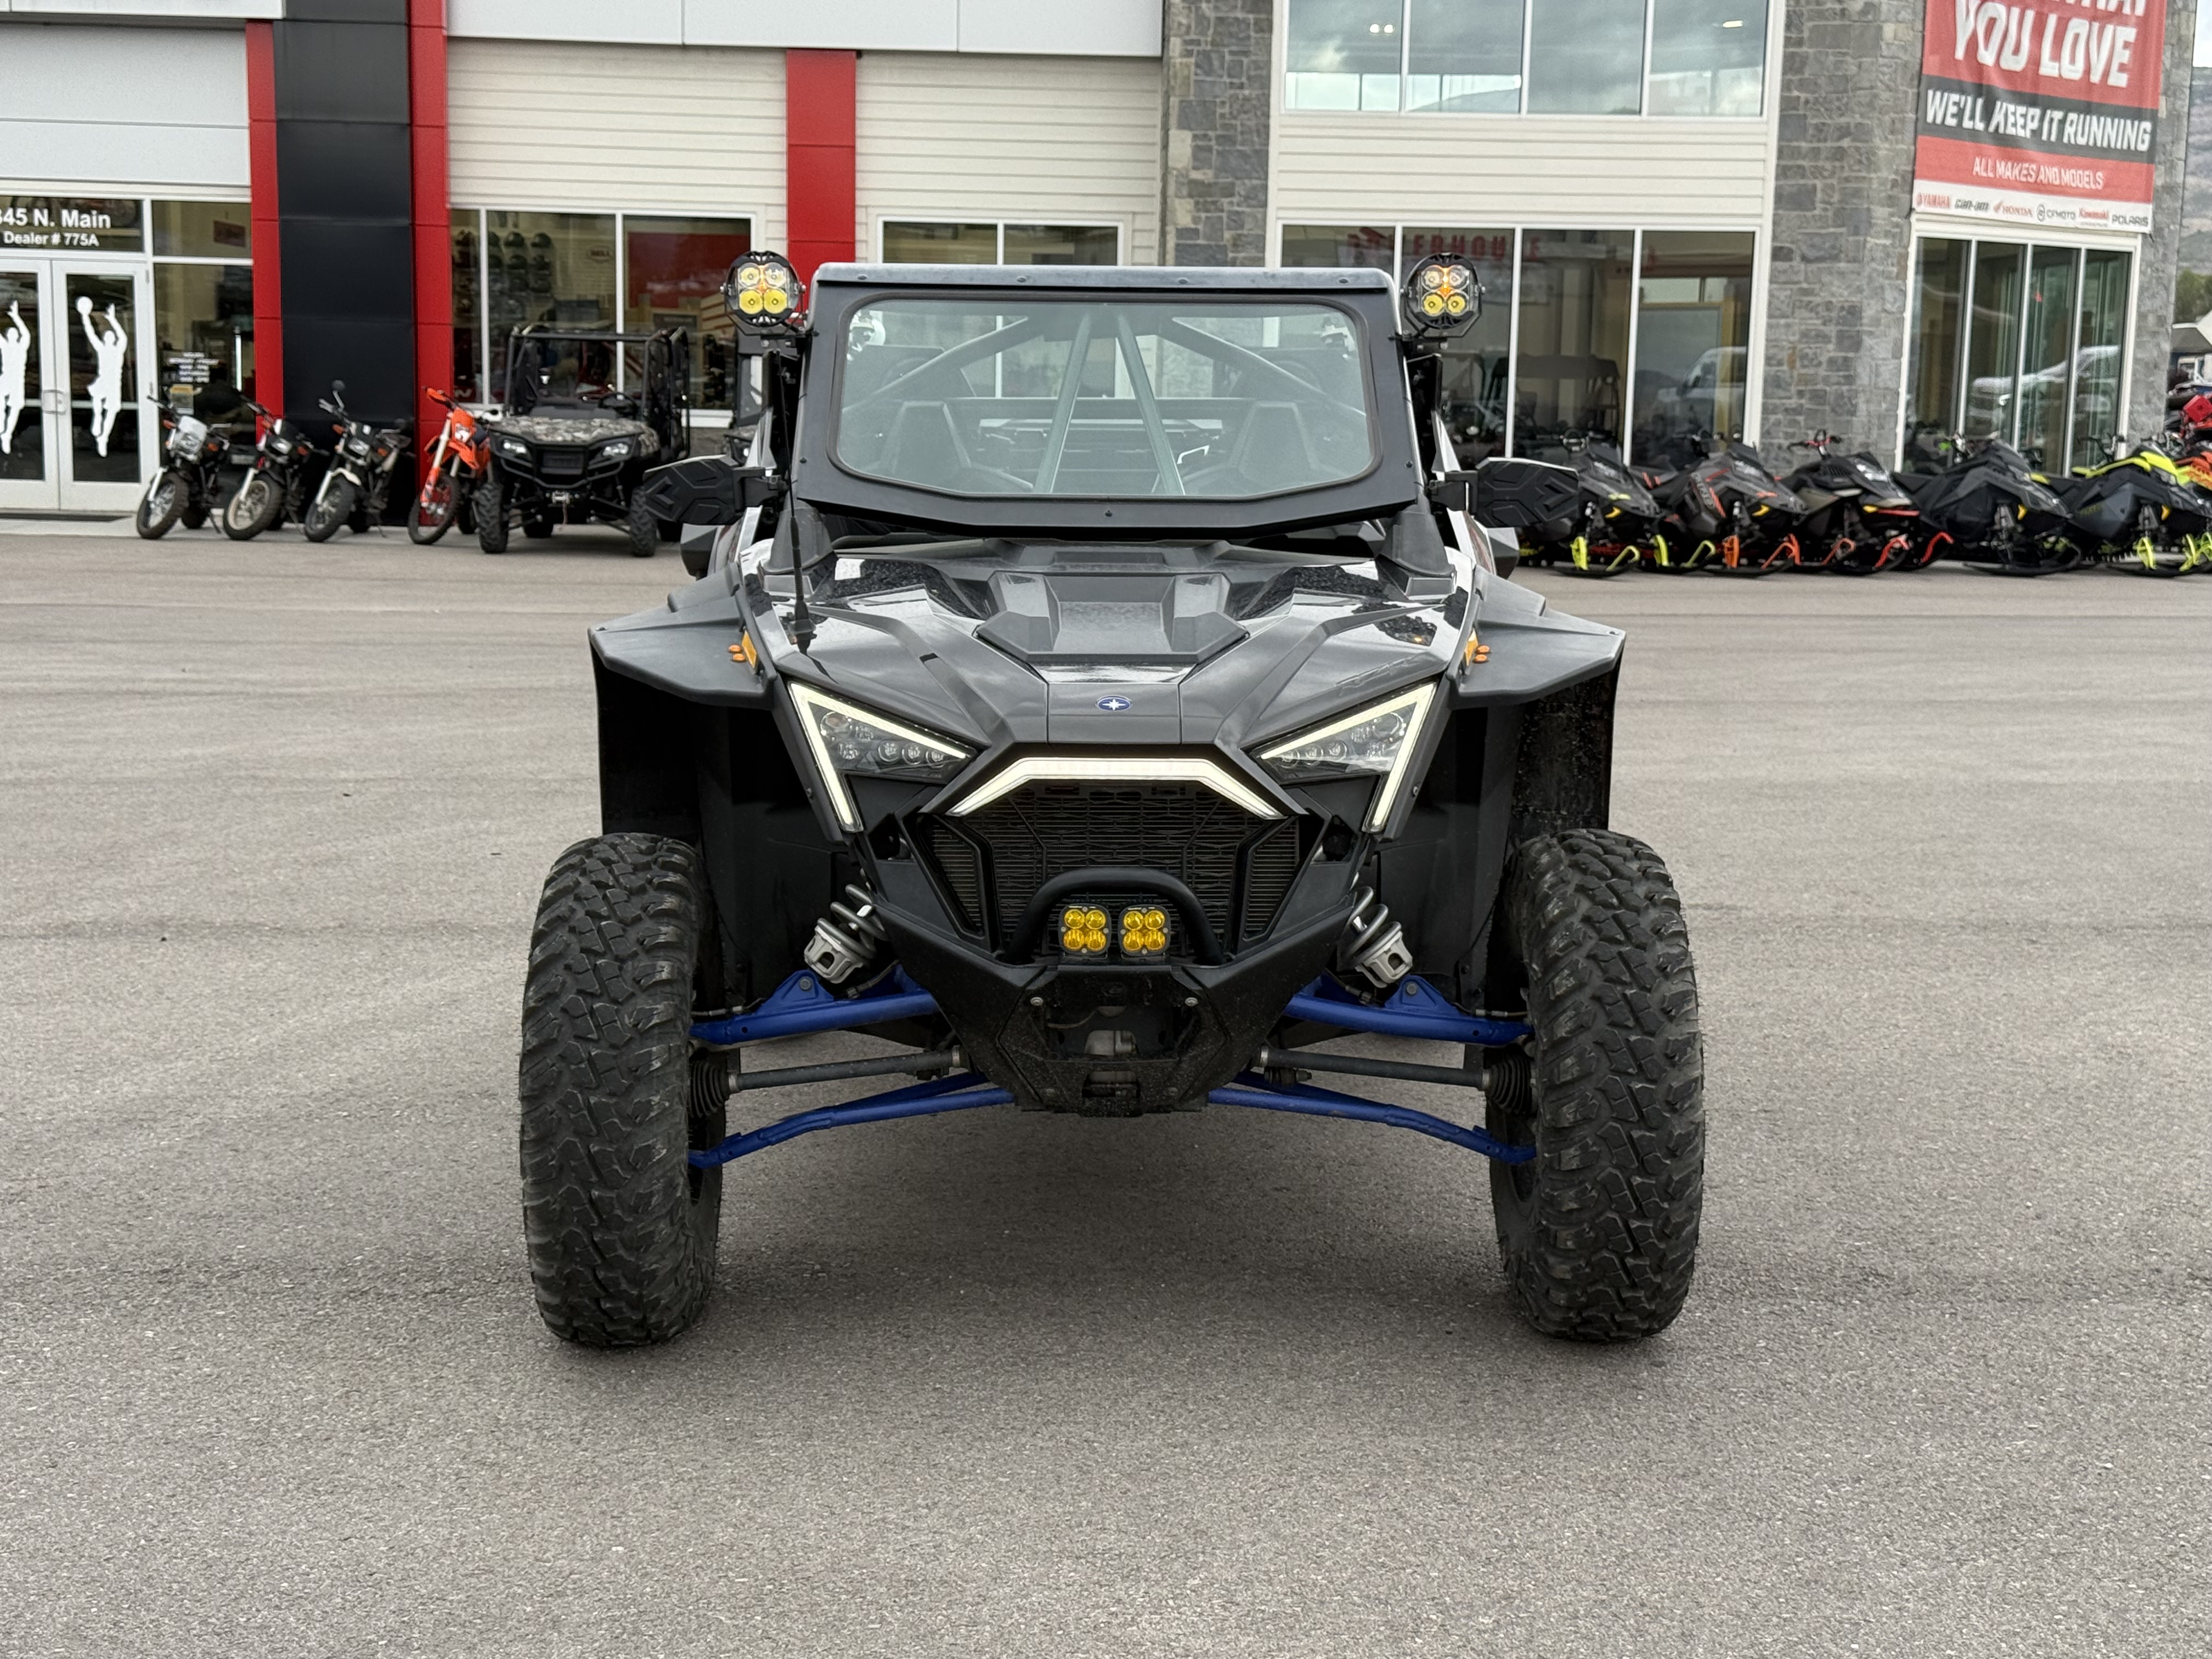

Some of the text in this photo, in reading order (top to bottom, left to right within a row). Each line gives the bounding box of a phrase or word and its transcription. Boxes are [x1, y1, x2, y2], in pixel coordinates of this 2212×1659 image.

[1954, 0, 2137, 88] YOU LOVE
[1926, 89, 2152, 151] WE'LL KEEP IT RUNNING
[1973, 156, 2104, 190] ALL MAKES AND MODELS
[0, 207, 111, 229] 45 N. Main
[2002, 205, 2032, 217] HONDA
[2112, 214, 2148, 227] POLARIS
[3, 230, 100, 246] Dealer # 775A
